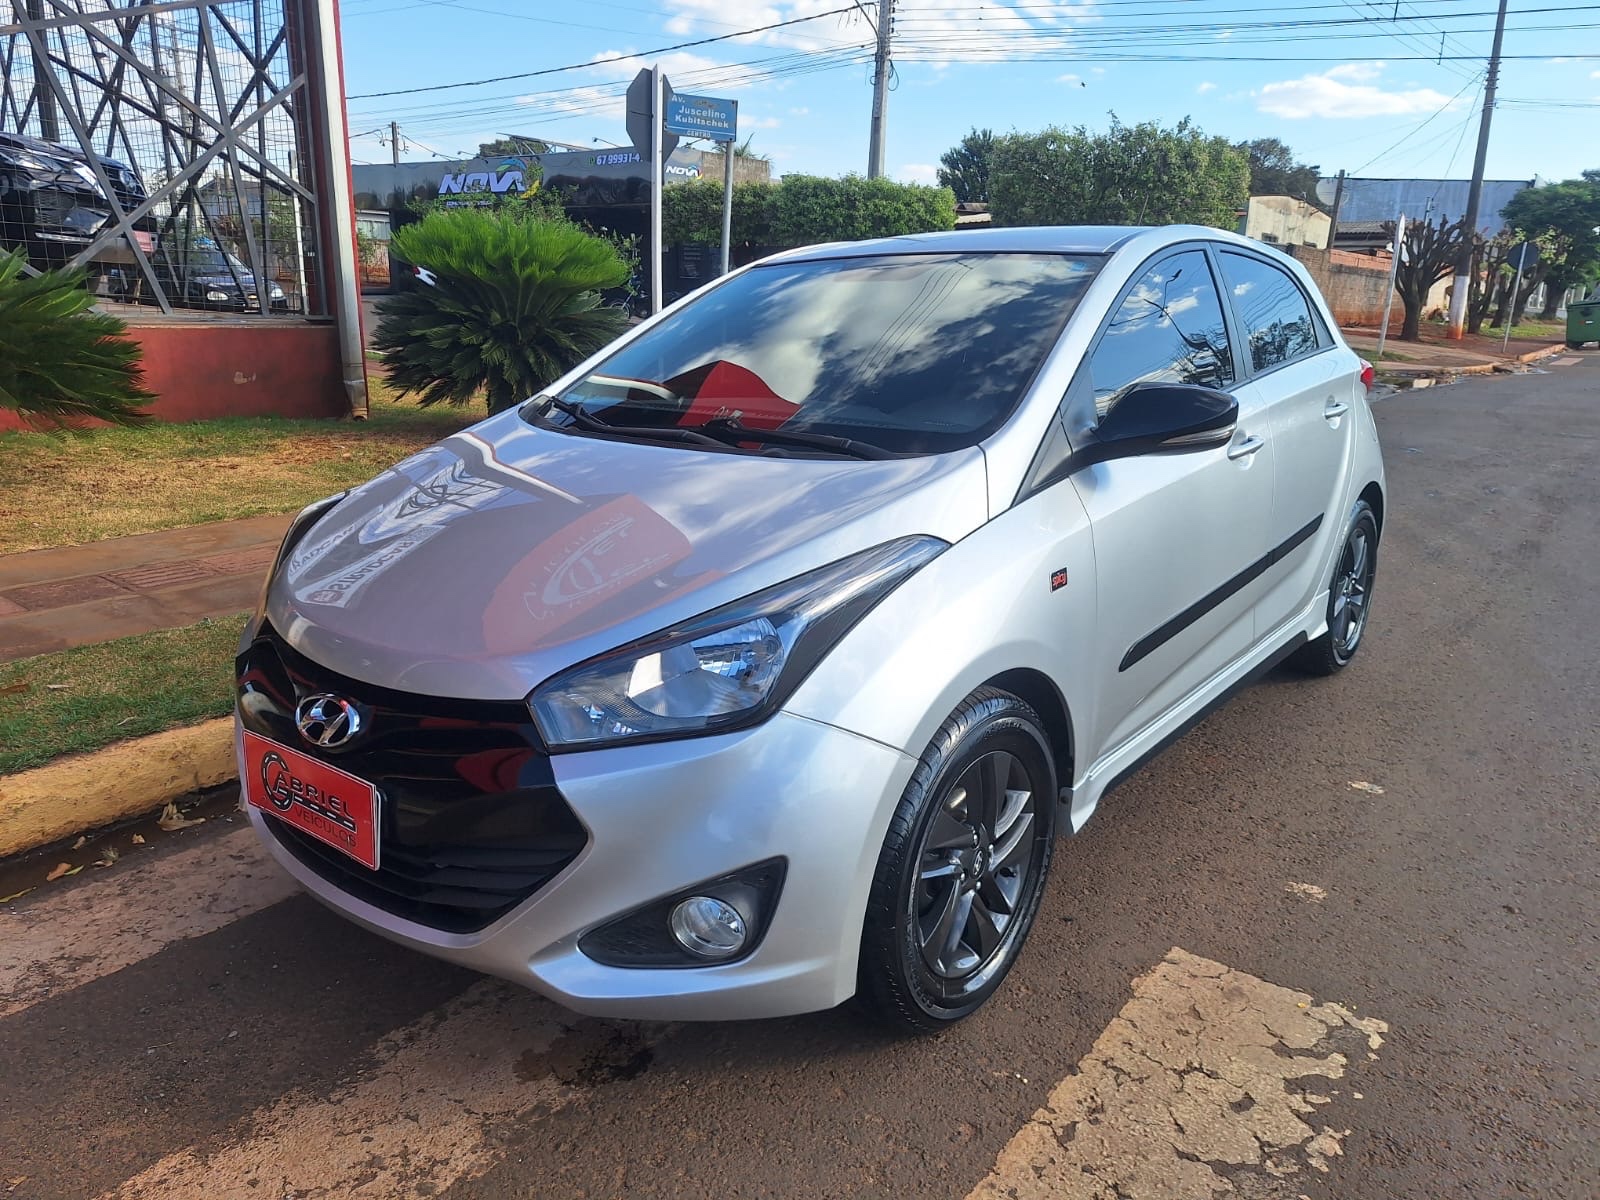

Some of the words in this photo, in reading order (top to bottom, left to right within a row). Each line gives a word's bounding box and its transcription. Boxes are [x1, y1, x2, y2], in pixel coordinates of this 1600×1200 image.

[671, 94, 686, 103] Av.
[679, 105, 726, 119] Juscelino
[675, 114, 729, 129] Kubitschek
[687, 130, 711, 138] CENTRO
[596, 155, 606, 165] 67
[608, 153, 643, 164] 99931-4
[665, 165, 700, 177] NOVA
[438, 170, 526, 194] NOVA
[261, 751, 356, 826] GABRIEL
[293, 806, 357, 848] VEICULOS
